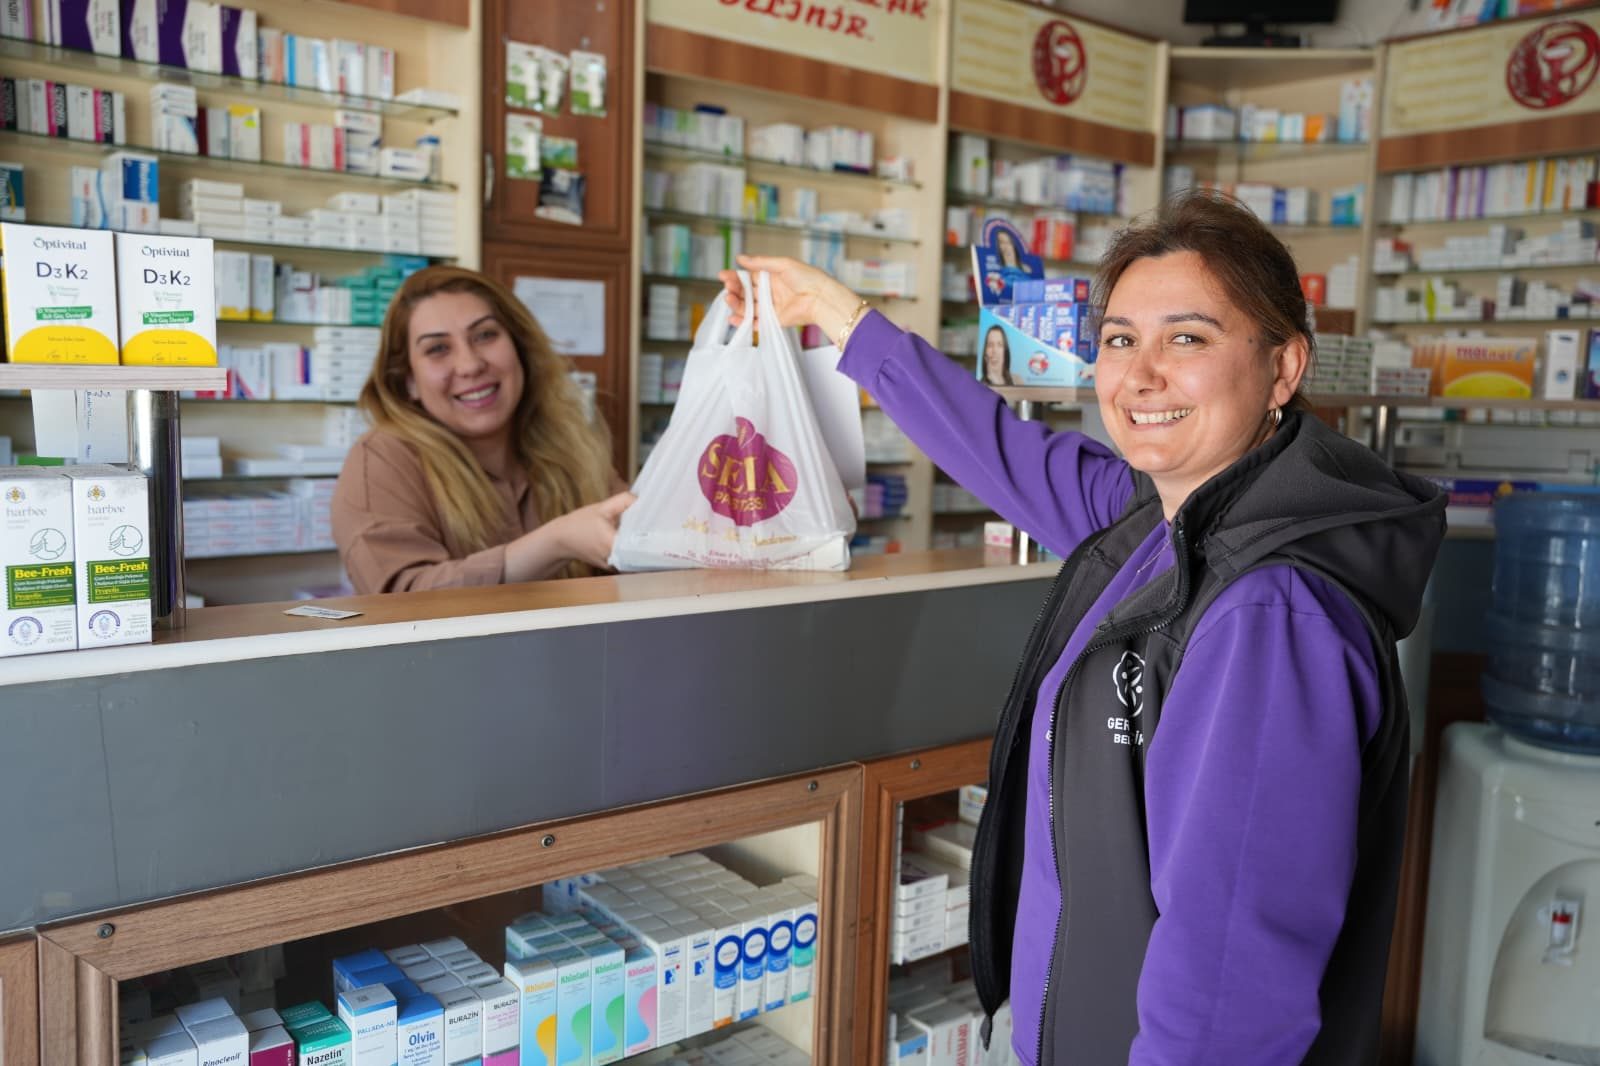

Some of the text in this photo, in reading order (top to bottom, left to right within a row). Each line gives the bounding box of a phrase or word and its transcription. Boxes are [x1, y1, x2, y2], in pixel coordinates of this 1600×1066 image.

[33, 237, 87, 250] Optivital
[141, 246, 190, 258] Optivital
[88, 503, 125, 514] harbee
[15, 566, 72, 579] Bee-Fresh
[94, 561, 148, 574] Bee-Fresh
[408, 1031, 435, 1046] Olvin
[307, 1049, 342, 1066] Nazetin
